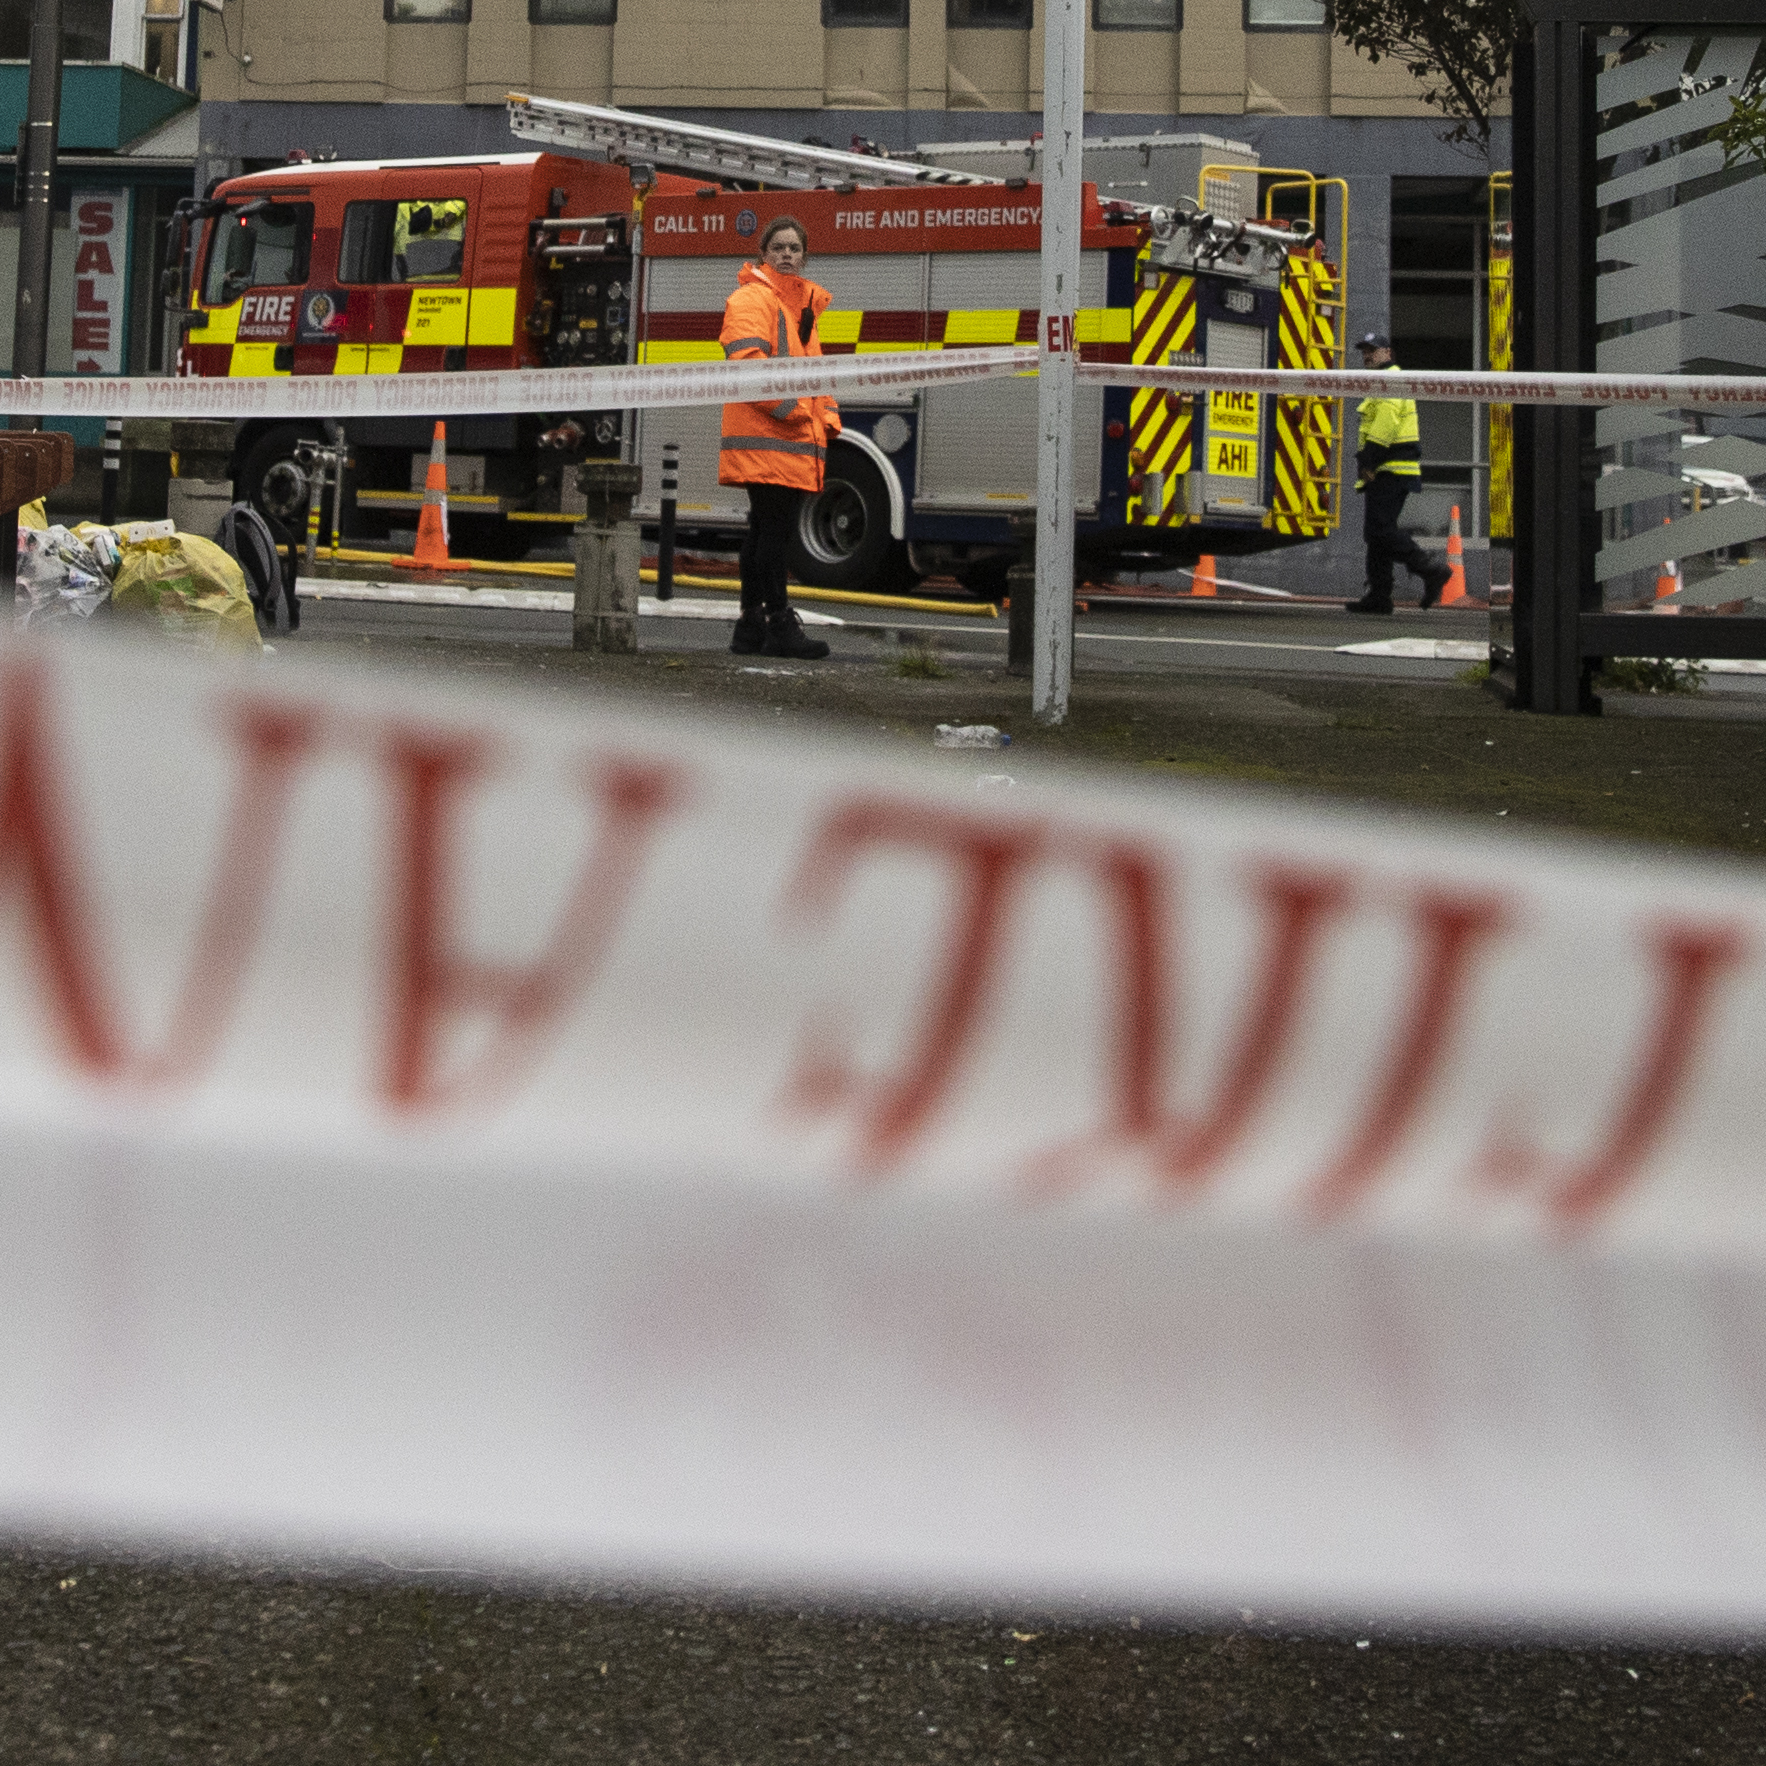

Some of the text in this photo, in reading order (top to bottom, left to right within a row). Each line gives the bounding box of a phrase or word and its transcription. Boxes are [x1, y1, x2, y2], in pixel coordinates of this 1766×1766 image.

[654, 215, 697, 234] CALL
[702, 214, 725, 232] 111
[835, 211, 875, 229] FIRE
[879, 209, 919, 228] AND
[71, 201, 114, 351] SALE
[241, 296, 296, 322] FIRE
[418, 295, 462, 306] NEWTOWN
[238, 324, 289, 337] EMERGENCY
[416, 318, 431, 328] 221
[1213, 413, 1253, 427] EMERGENCY
[1217, 442, 1248, 472] AHI
